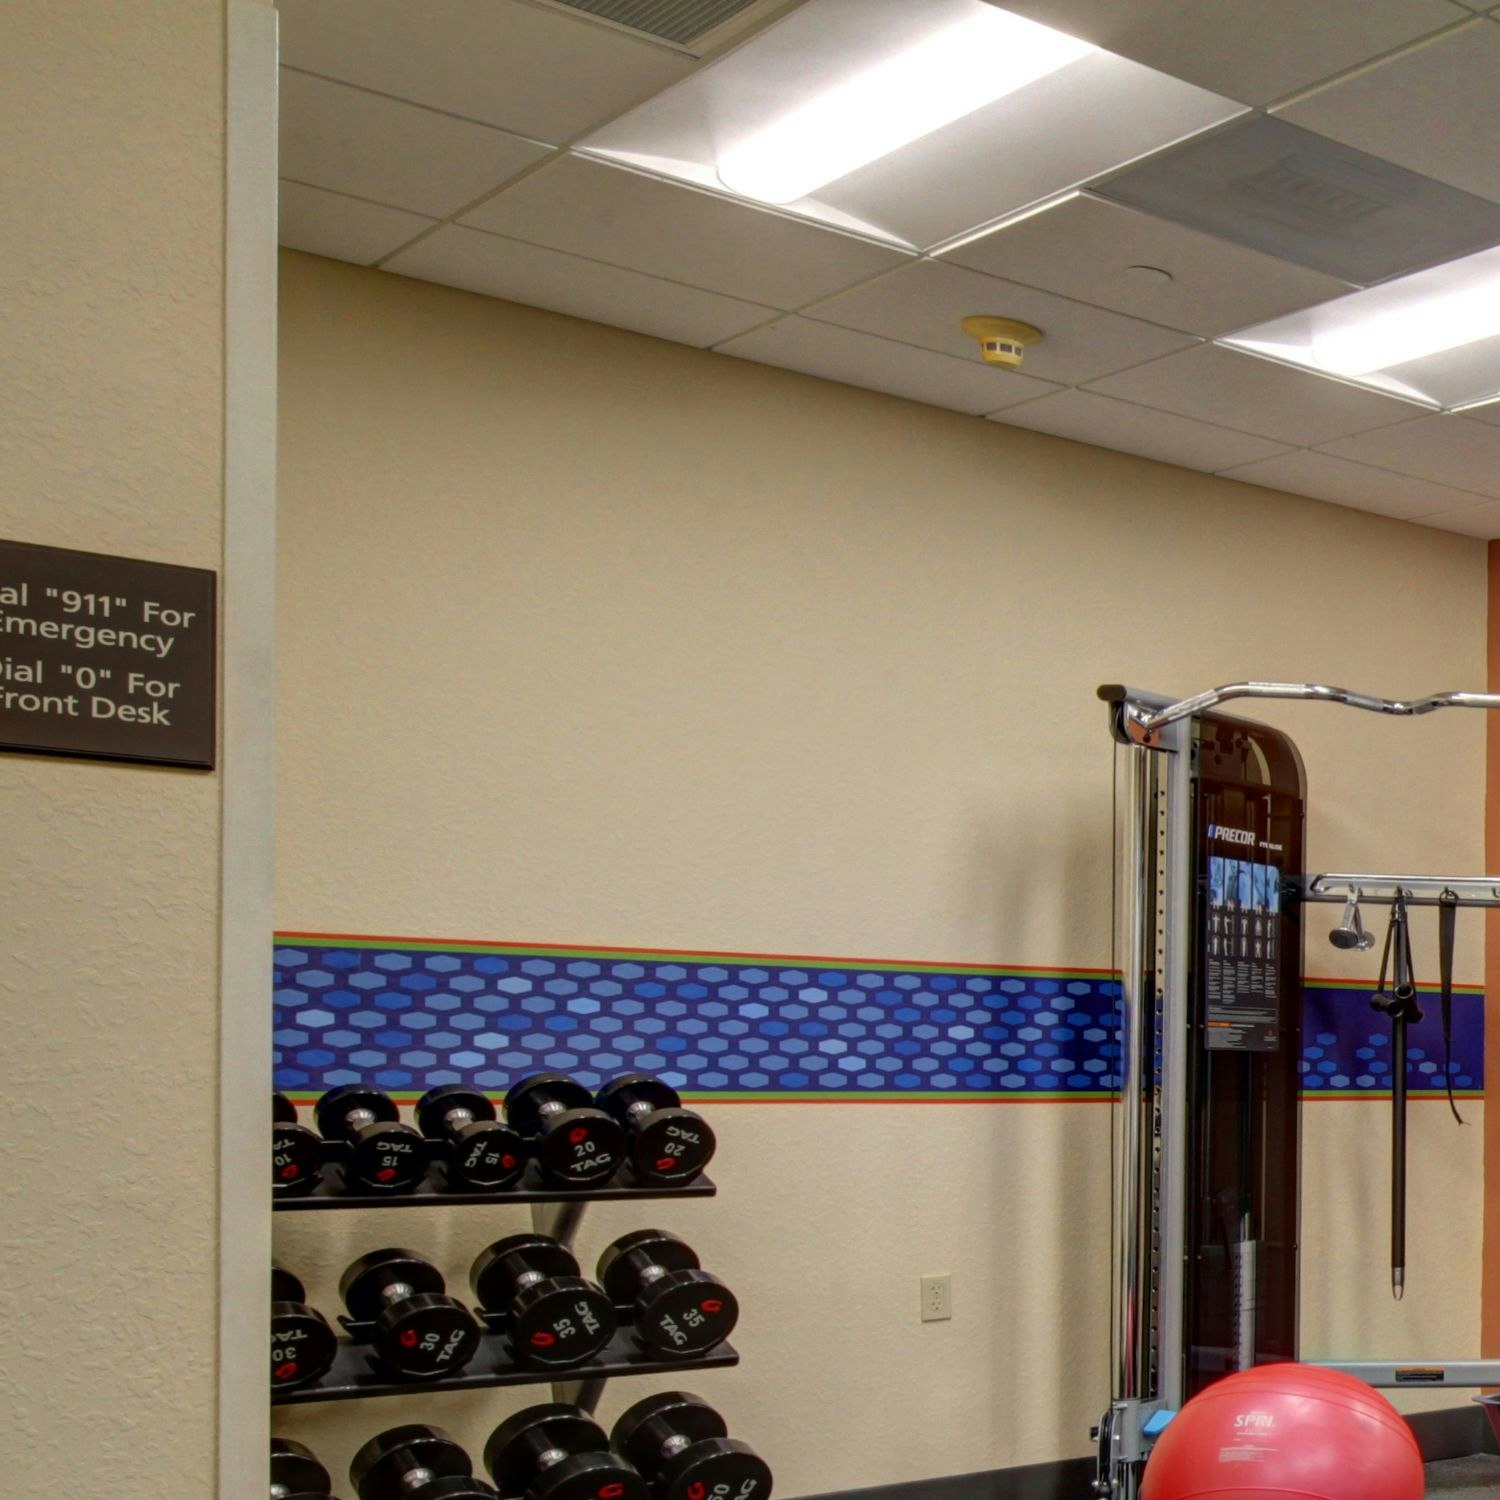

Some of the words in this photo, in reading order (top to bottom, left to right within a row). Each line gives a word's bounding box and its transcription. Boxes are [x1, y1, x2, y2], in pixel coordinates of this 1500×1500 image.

[46, 587, 127, 617] "911"
[143, 601, 196, 628] For
[0, 610, 175, 658] mergency
[0, 656, 43, 684] ial
[61, 664, 111, 690] "0"
[128, 672, 181, 699] For
[0, 686, 79, 717] ront
[91, 696, 171, 726] Desk
[1213, 825, 1255, 847] PRECOR
[273, 1138, 296, 1151] TA
[664, 1125, 701, 1145] TAG
[376, 1141, 413, 1153] TAG
[463, 1140, 488, 1168] TAG
[574, 1141, 596, 1157] 20
[664, 1141, 686, 1157] 20
[274, 1152, 292, 1167] 10
[381, 1155, 400, 1167] 15
[484, 1151, 500, 1166] 15
[570, 1153, 612, 1173] TAG
[574, 1301, 602, 1336] TAG
[682, 1308, 707, 1328] 35
[271, 1328, 308, 1342] TA
[553, 1318, 577, 1339] 35
[658, 1314, 688, 1346] TAG
[419, 1332, 441, 1351] 30
[436, 1329, 466, 1363] TAG
[272, 1346, 297, 1362] 30
